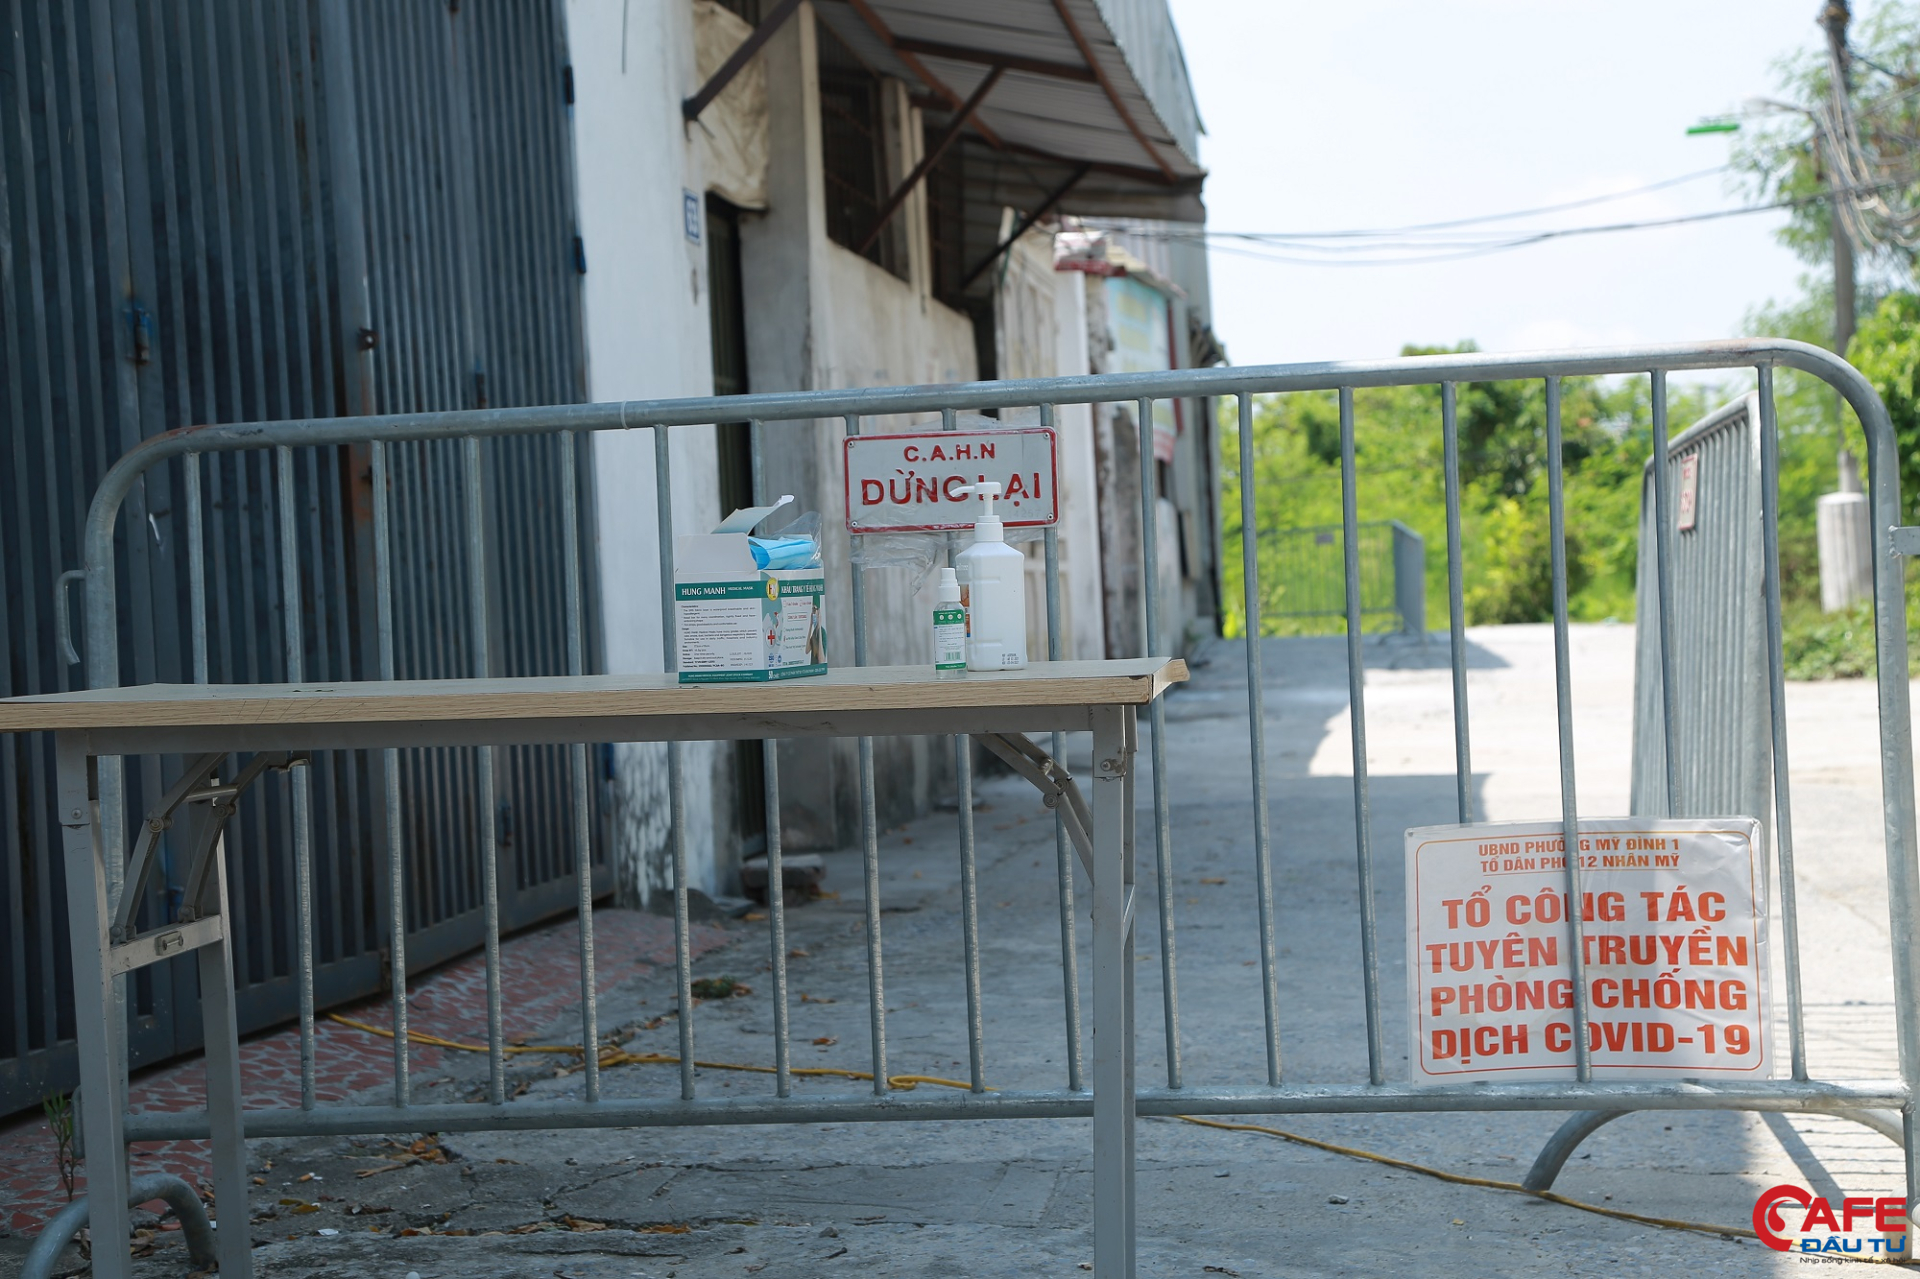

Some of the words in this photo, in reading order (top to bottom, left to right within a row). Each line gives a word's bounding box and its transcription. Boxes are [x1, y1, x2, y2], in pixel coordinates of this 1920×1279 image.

[904, 443, 995, 462] C.A.H.N
[861, 469, 968, 505] DỪNG
[1479, 843, 1520, 857] UBND
[1525, 838, 1590, 853] PHƯỜG
[1596, 836, 1619, 850] MỸ
[1626, 836, 1666, 850] ĐÌNH
[1671, 839, 1679, 850] 1
[1504, 857, 1535, 871] DÂN
[1541, 857, 1566, 869] PH
[1579, 856, 1597, 867] 12
[1603, 853, 1649, 867] NHÂN
[1655, 852, 1680, 867] MỸ
[1442, 884, 1492, 929] TỔ
[1640, 885, 1726, 922] TÁC
[1426, 931, 1558, 974] TUYÊN
[1583, 925, 1748, 966] TRUYỀN
[1431, 975, 1574, 1017] PHÒNG
[1591, 968, 1748, 1010] CHỐNG
[1432, 1024, 1529, 1065] DỊCH
[1545, 1022, 1751, 1055] COVID-19
